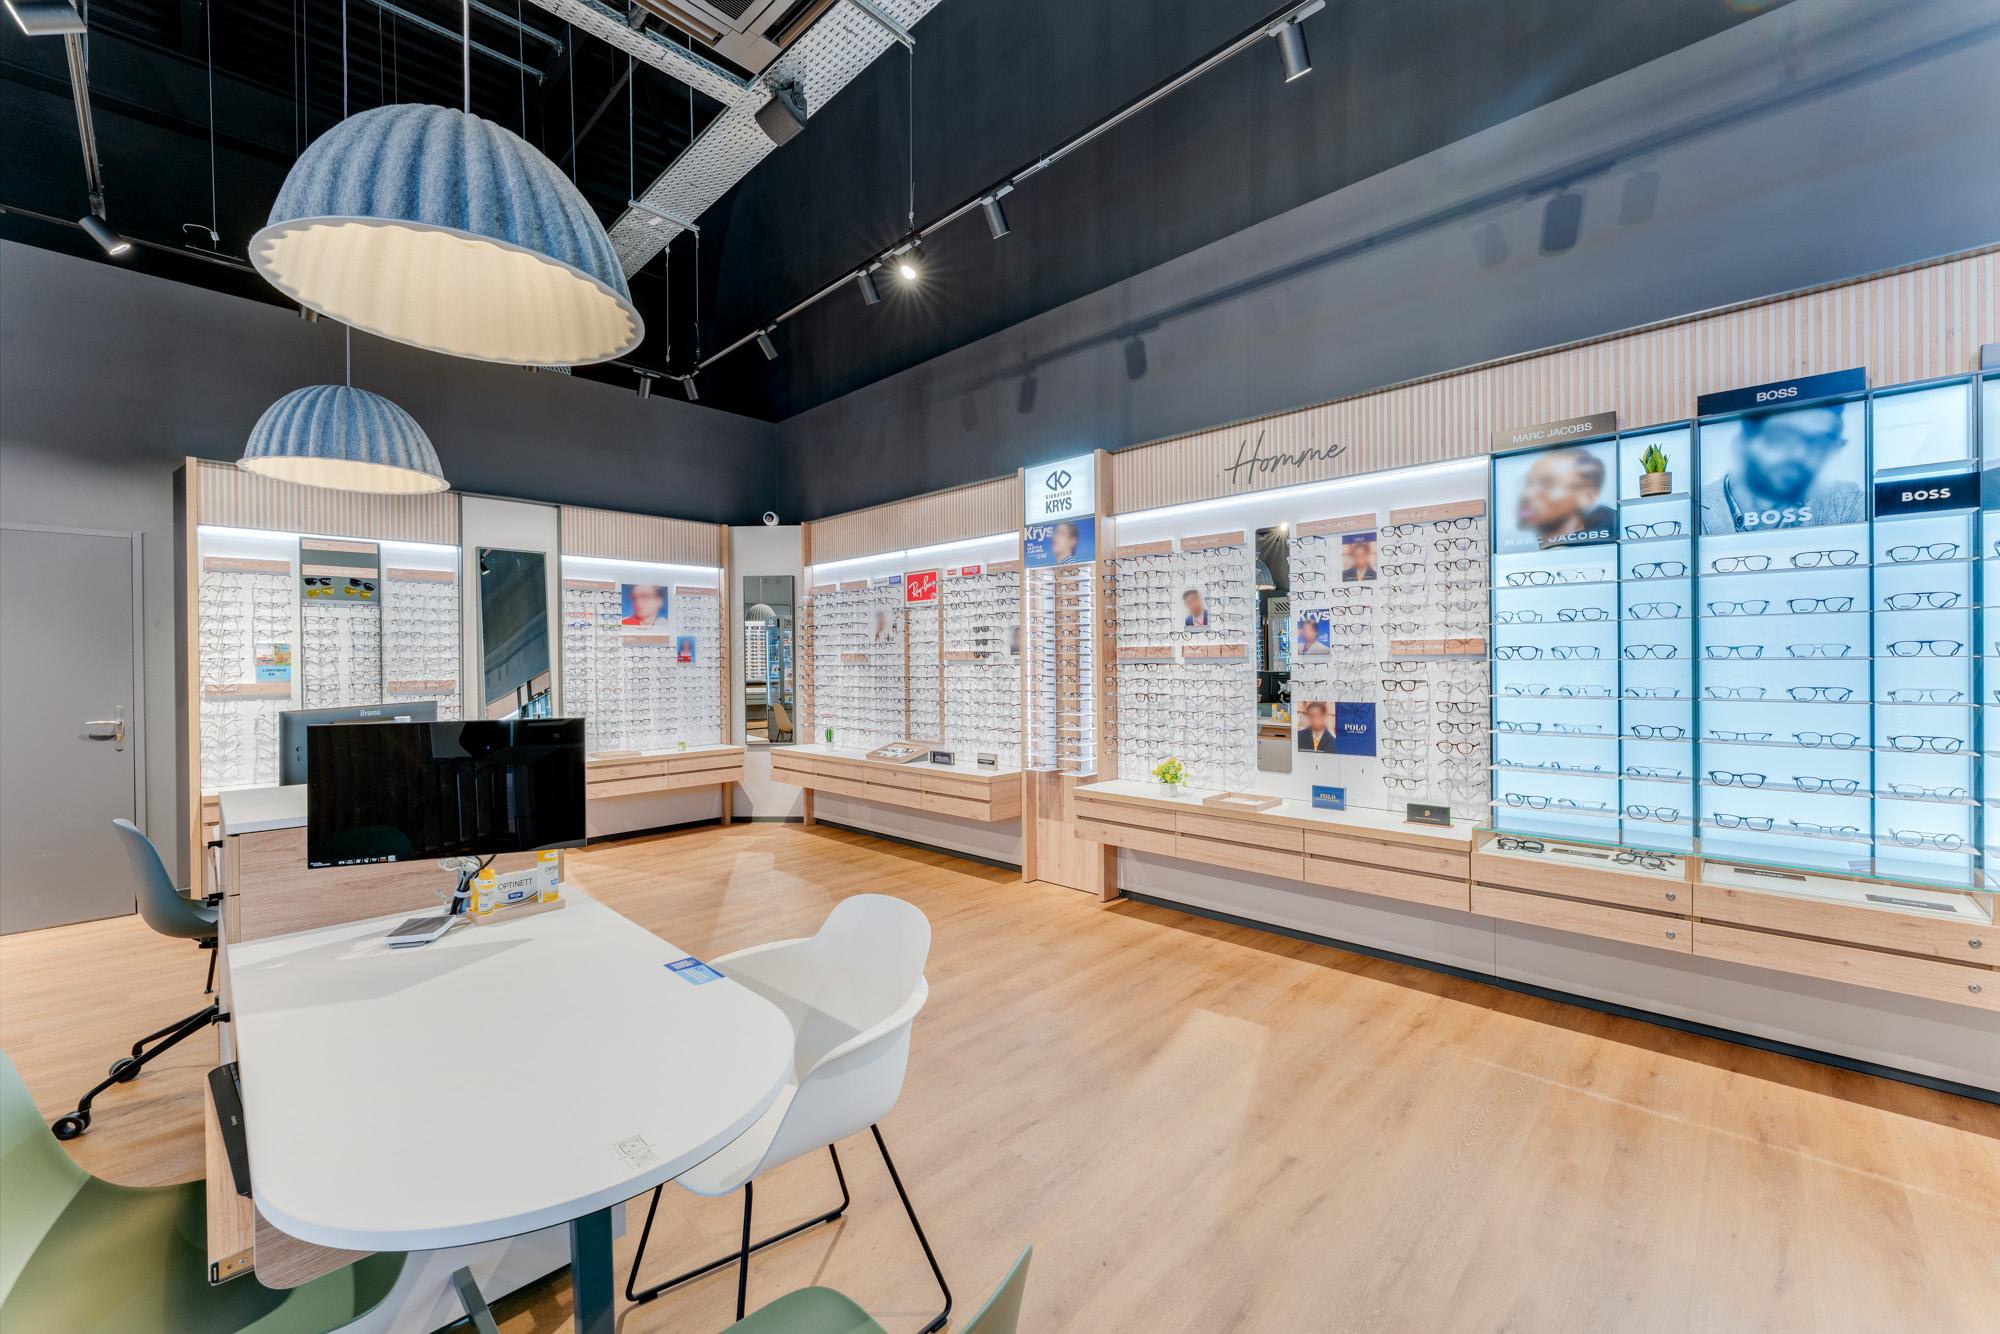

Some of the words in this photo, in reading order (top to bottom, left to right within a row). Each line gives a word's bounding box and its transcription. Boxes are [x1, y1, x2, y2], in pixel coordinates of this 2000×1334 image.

[1756, 387, 1798, 402] BOSS
[1512, 431, 1545, 443] MARC
[1547, 422, 1593, 438] JACOBS
[1224, 429, 1347, 484] Homme
[1045, 490, 1073, 500] SIGNATURE
[1901, 488, 1951, 502] BOSS
[1045, 497, 1073, 514] KRYS
[1743, 506, 1813, 527] BOSS
[1024, 525, 1053, 542] Krys
[1548, 529, 1610, 543] JACOBS
[1344, 723, 1367, 731] POLO
[497, 878, 534, 891] OPTINETT
